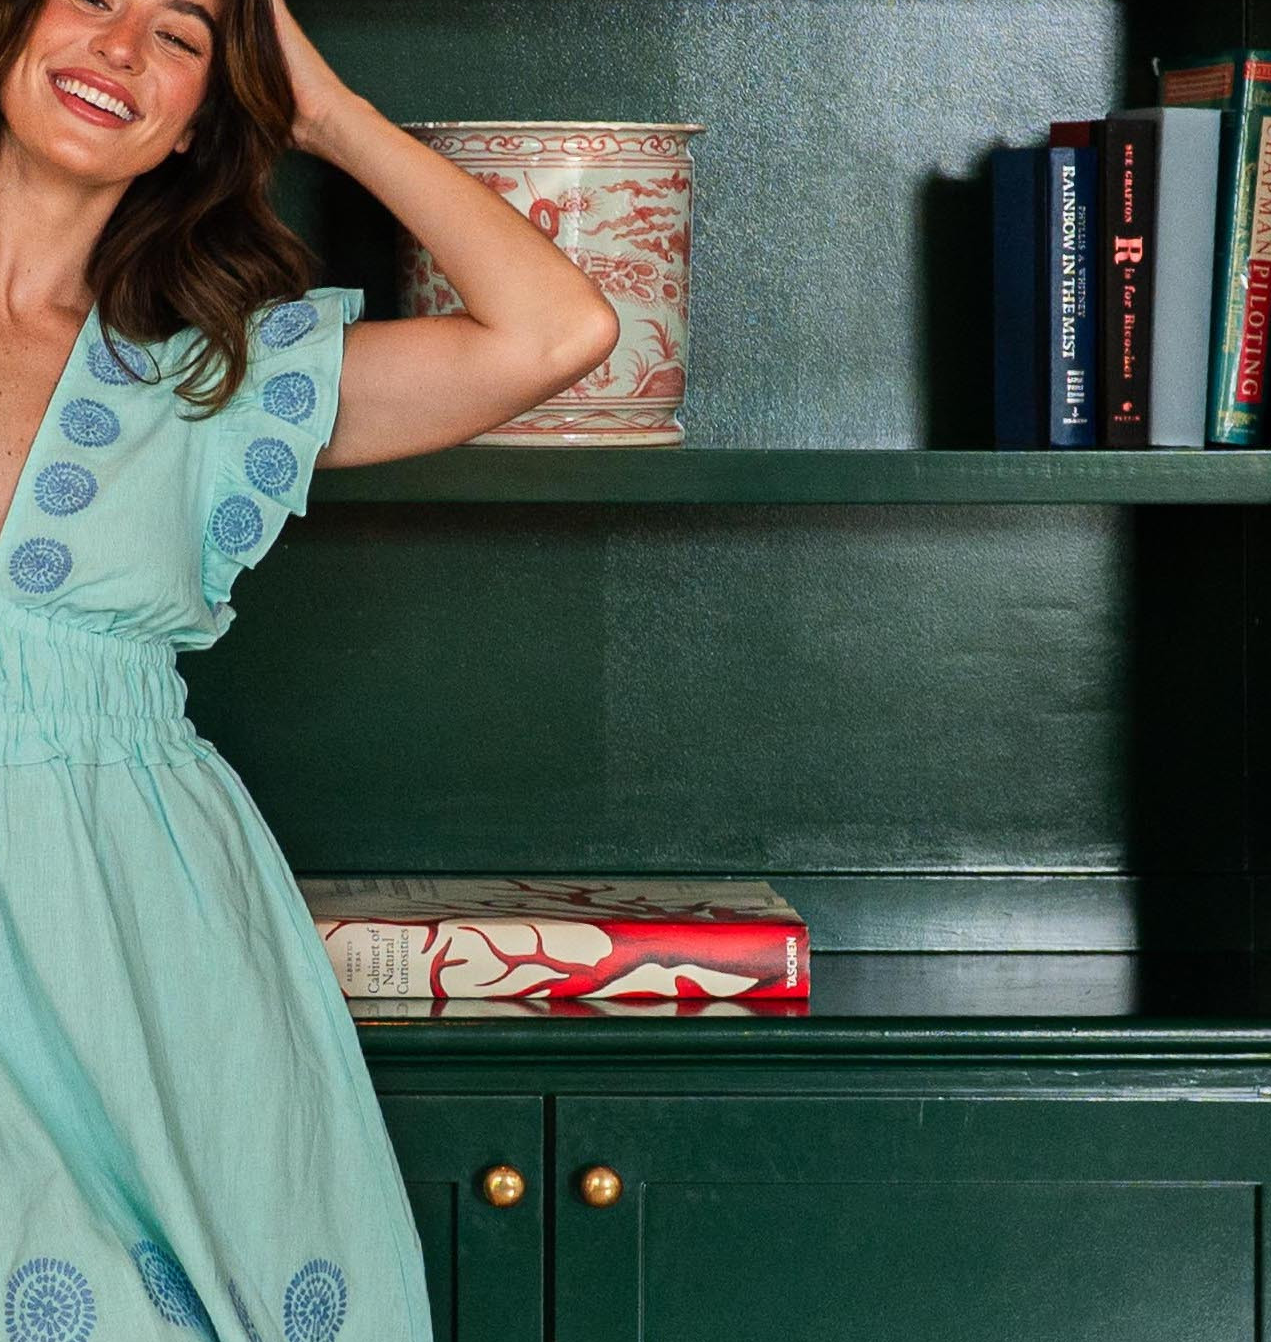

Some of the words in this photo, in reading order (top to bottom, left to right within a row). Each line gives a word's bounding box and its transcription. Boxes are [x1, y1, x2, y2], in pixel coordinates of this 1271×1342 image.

[1124, 144, 1134, 166] SUE
[1062, 164, 1076, 251] RAINBOW
[1124, 170, 1134, 224] GRAFTON
[1078, 205, 1087, 251] PHYLLIS
[1114, 235, 1144, 265] R
[1062, 253, 1076, 276] IN
[1124, 267, 1135, 280] is
[1062, 277, 1076, 314] THE
[1077, 267, 1086, 319] WHITNEY
[1124, 284, 1136, 308] for
[1062, 316, 1076, 360] MIST
[1123, 313, 1136, 380] Ricochet
[1241, 264, 1271, 398] PILOTING
[367, 927, 381, 944] of
[367, 947, 381, 995] Cabinet
[383, 936, 395, 986] Natural
[396, 928, 410, 996] Curiosities
[786, 936, 797, 989] TASCHEN
